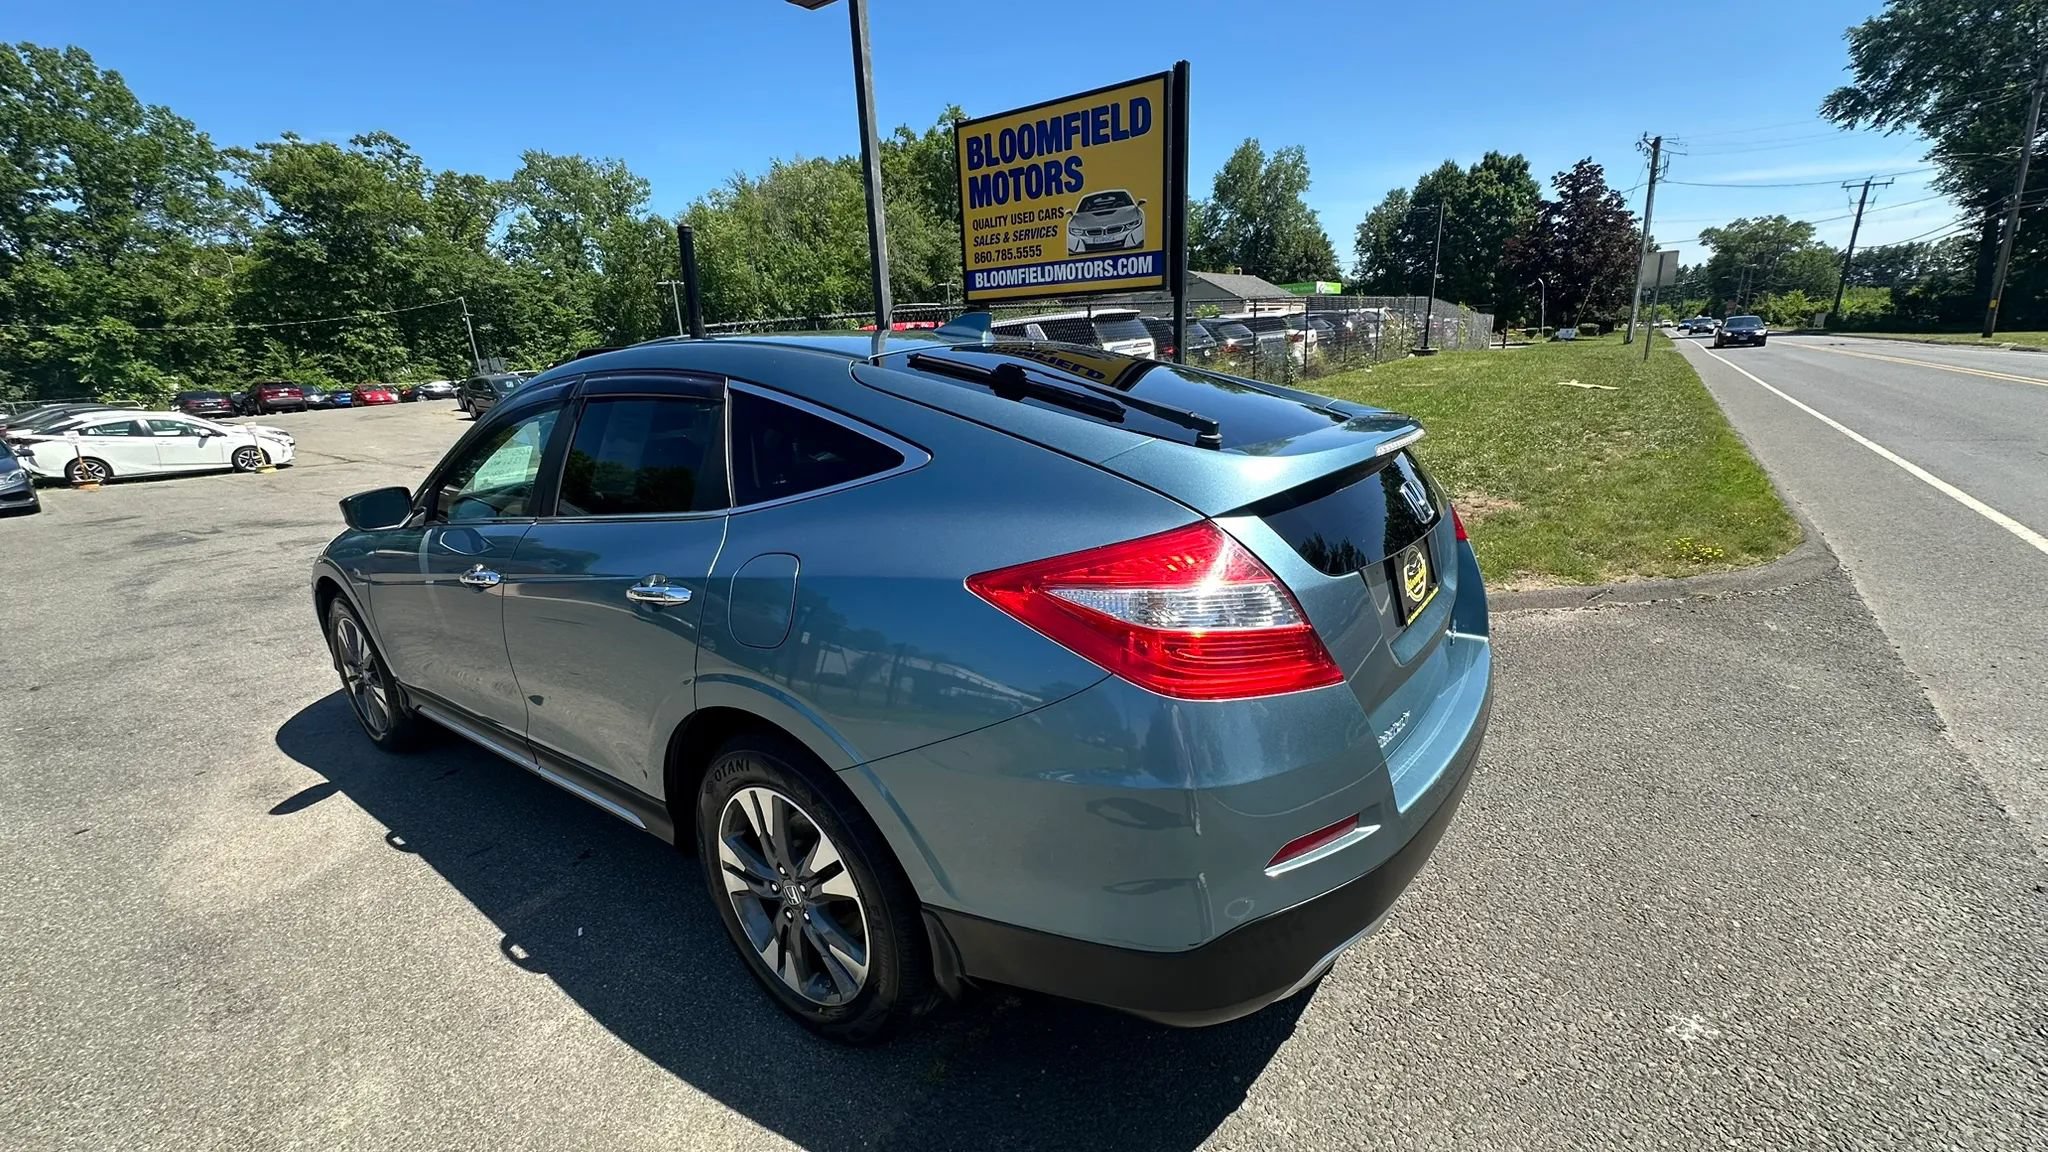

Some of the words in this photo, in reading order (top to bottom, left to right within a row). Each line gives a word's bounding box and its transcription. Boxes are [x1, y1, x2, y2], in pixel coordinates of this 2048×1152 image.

[966, 97, 1152, 171] BLOOMFIELD
[968, 155, 1084, 209] MOTORS
[972, 215, 1008, 231] QUALITY
[1011, 211, 1035, 225] USED
[1038, 206, 1064, 221] CARS
[973, 233, 1001, 247] SALES
[1003, 232, 1010, 244] &
[1012, 225, 1058, 242] SERVICES
[974, 245, 1042, 264] 860.785.5555
[975, 255, 1153, 289] BLOOMFIELDMOTORS.COM
[714, 759, 750, 782] OTANI
